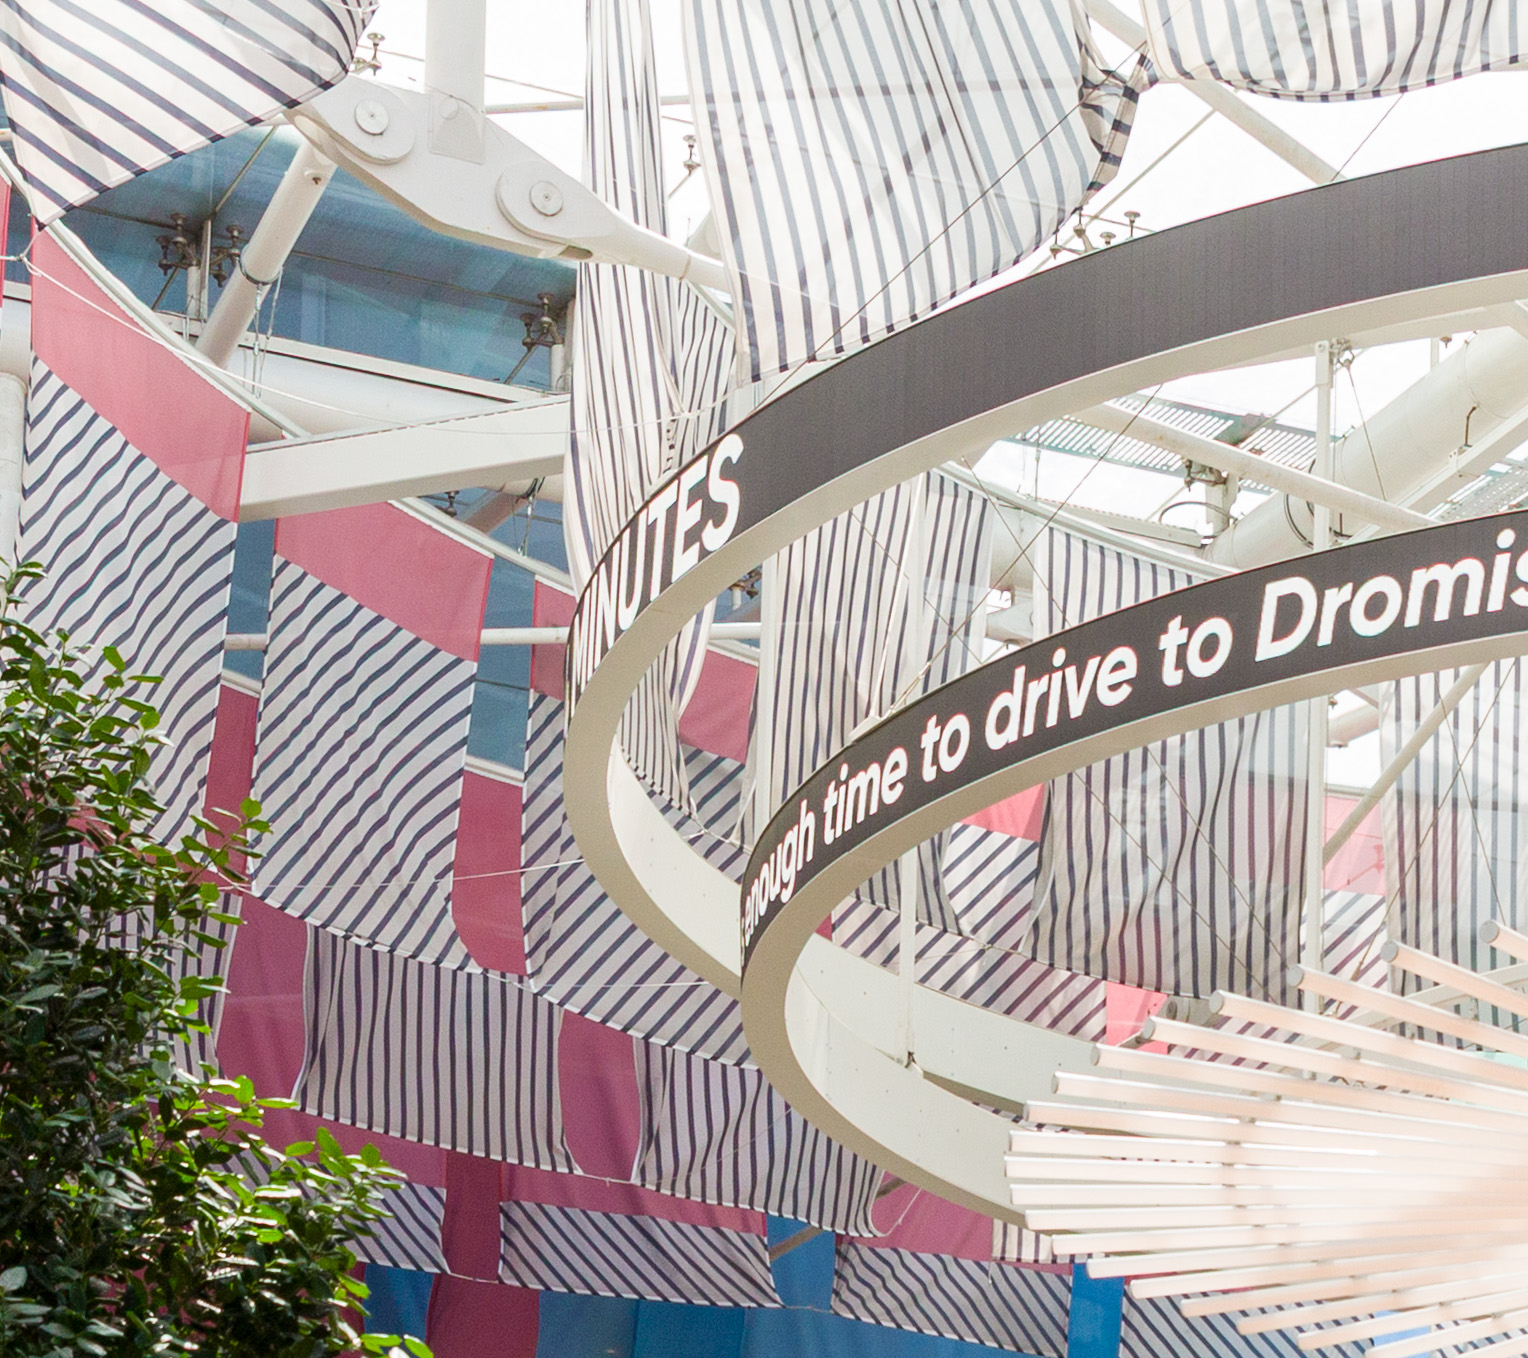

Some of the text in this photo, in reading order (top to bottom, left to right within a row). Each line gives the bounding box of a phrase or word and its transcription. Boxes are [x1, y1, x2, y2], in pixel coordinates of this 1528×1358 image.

[573, 432, 744, 690] MINUTES
[745, 800, 815, 952] enough
[824, 747, 906, 845] time
[920, 709, 968, 779] to
[986, 630, 1136, 749] drive
[1160, 594, 1230, 688] to
